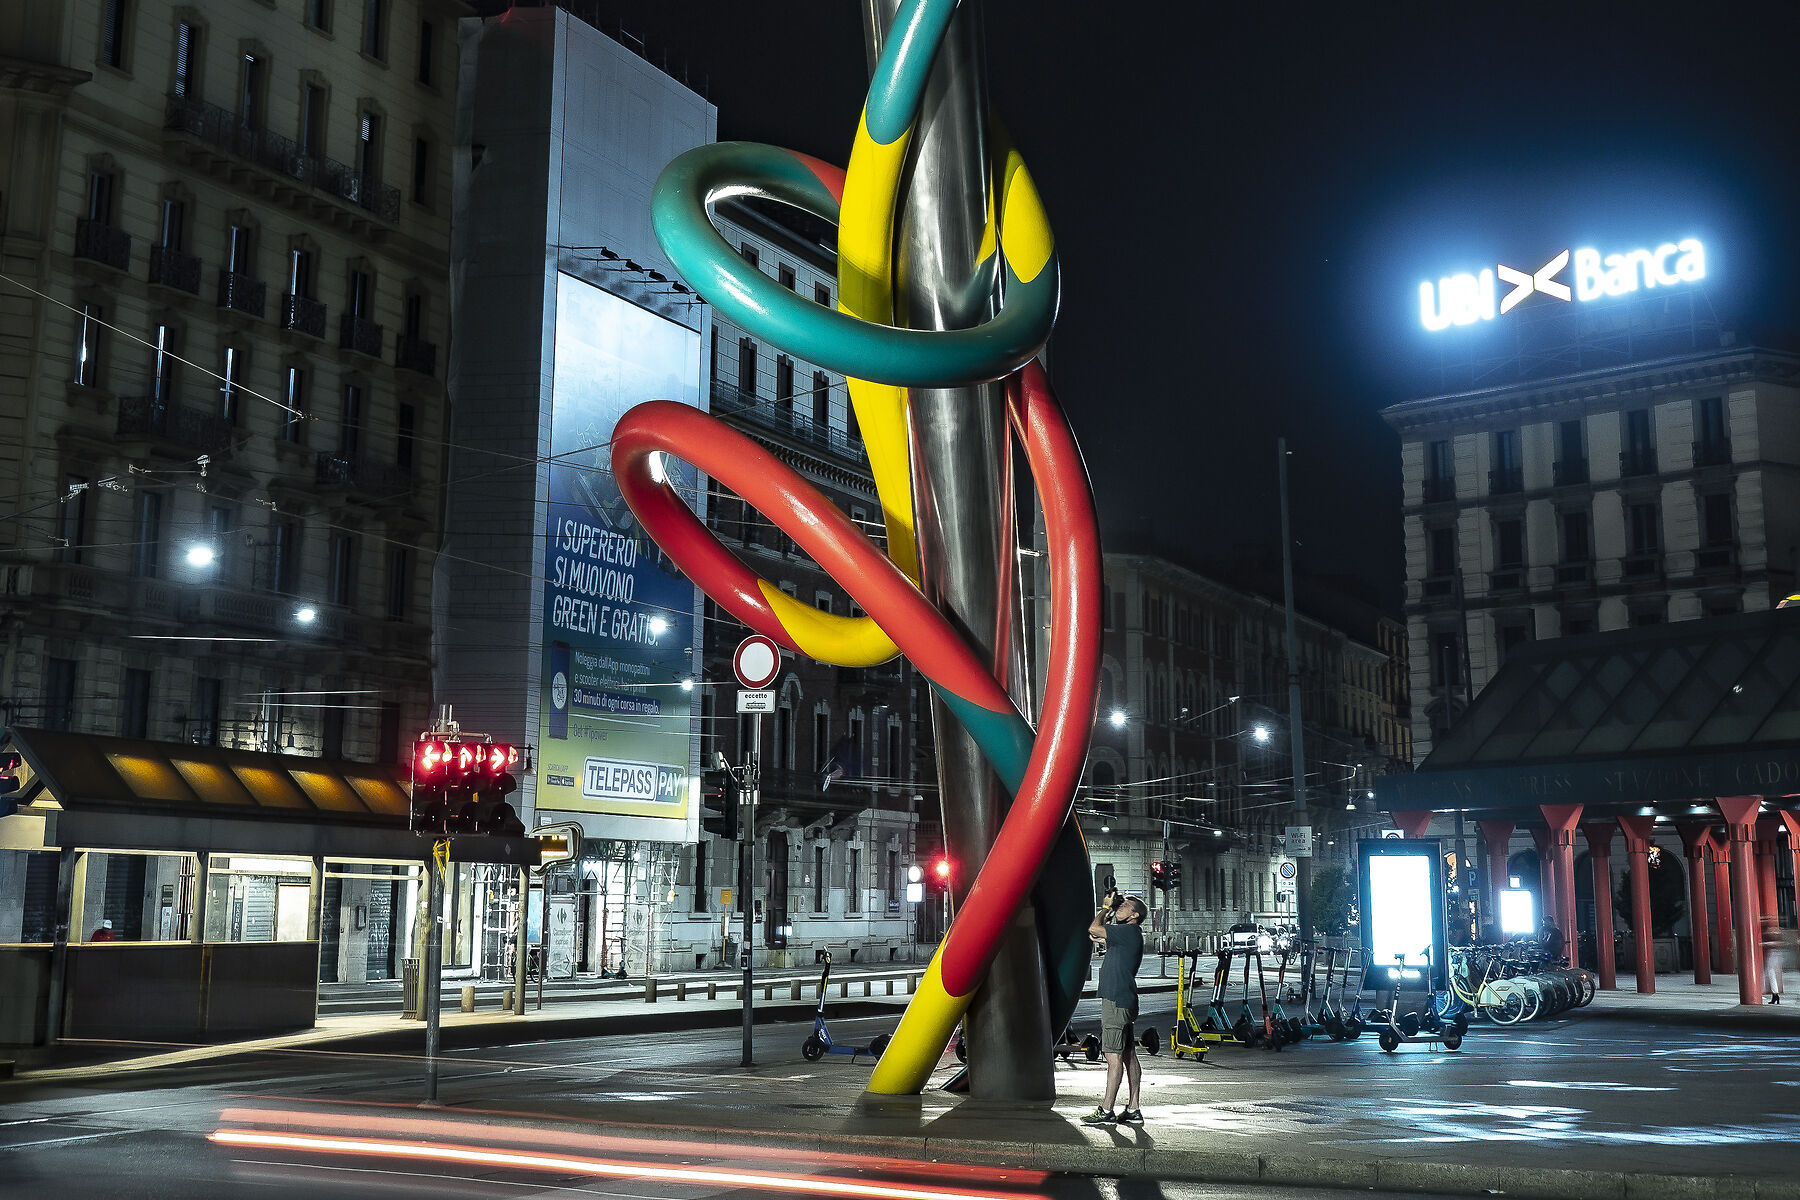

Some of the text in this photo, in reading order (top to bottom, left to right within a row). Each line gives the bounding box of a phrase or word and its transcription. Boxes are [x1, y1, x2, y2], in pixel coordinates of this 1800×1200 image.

[1420, 237, 1707, 331] UBI Banca
[555, 516, 638, 568] I SUPEREROI
[553, 555, 634, 604] SI MUOVONO
[552, 594, 598, 635] GREEN
[599, 605, 611, 637] E
[573, 688, 583, 703] 30
[583, 691, 601, 706] minuti
[601, 693, 608, 707] di
[608, 696, 620, 712] ogni
[620, 699, 636, 711] corsa
[588, 764, 682, 797] TELEPASS PAY
[1468, 871, 1477, 887] P
